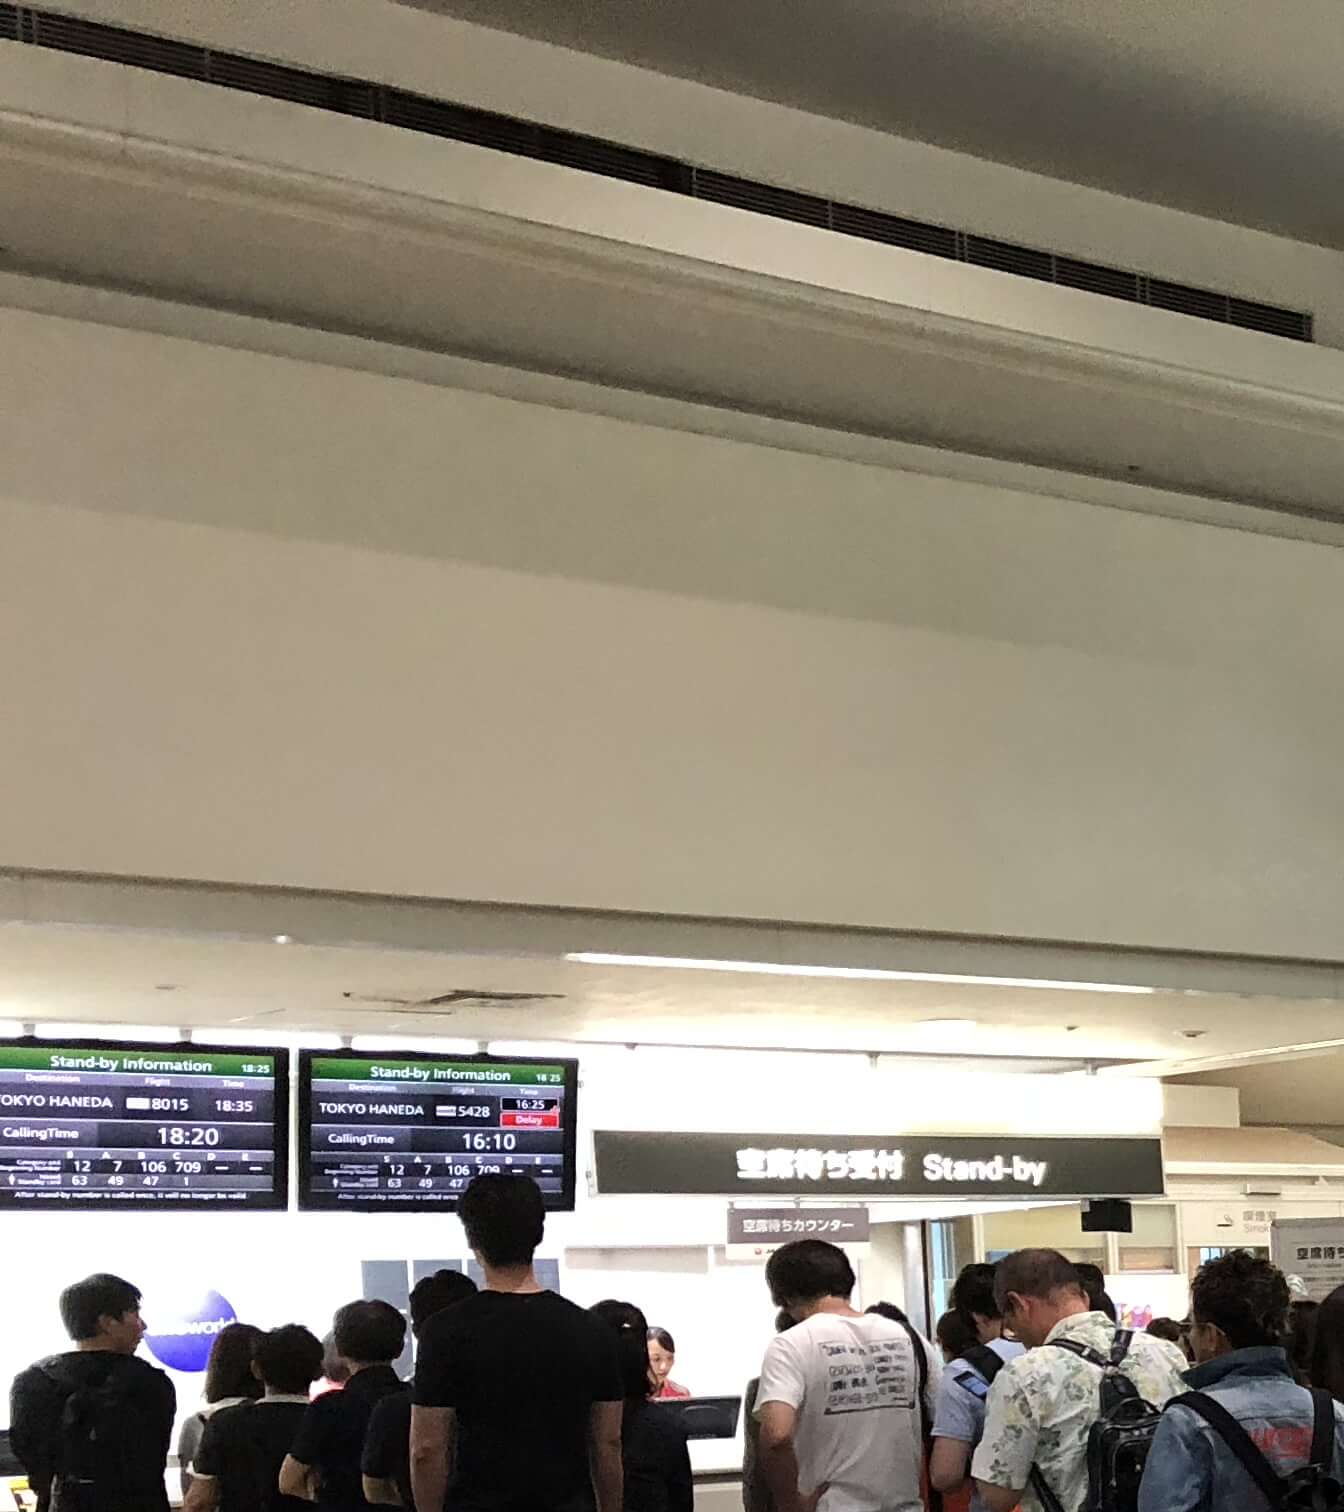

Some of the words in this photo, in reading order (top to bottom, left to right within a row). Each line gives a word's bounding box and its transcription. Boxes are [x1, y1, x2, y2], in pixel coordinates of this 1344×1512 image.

[50, 1055, 118, 1071] Stand-by
[123, 1058, 212, 1072] Information
[241, 1064, 270, 1073] 18:25
[370, 1066, 429, 1080] Stand-by
[434, 1068, 511, 1081] Information
[49, 1096, 113, 1108] HANEDA
[152, 1098, 189, 1111] 8015
[216, 1100, 254, 1112] 18:35
[516, 1100, 545, 1109] 16:25
[319, 1102, 365, 1114] TOKYO
[369, 1104, 424, 1115] HANEDA
[458, 1106, 490, 1118] 5428
[515, 1115, 543, 1125] Delay
[158, 1127, 219, 1145] 18:20
[463, 1133, 516, 1150] 16:10
[74, 1161, 91, 1172] 12
[113, 1161, 122, 1172] 7
[141, 1161, 167, 1173] 106
[175, 1161, 201, 1173] 709
[390, 1164, 405, 1175] 12
[424, 1164, 432, 1175] 7
[736, 1147, 905, 1181] 空席待ち受付
[923, 1153, 1047, 1186] Stand-by
[448, 1165, 470, 1175] 106
[72, 1176, 88, 1186] 63
[108, 1176, 124, 1186] 49
[143, 1176, 159, 1186] 47
[388, 1178, 402, 1188] 63
[418, 1178, 433, 1188] 49
[449, 1178, 463, 1188] 47
[743, 1218, 854, 1234] 空席待ちカウンター
